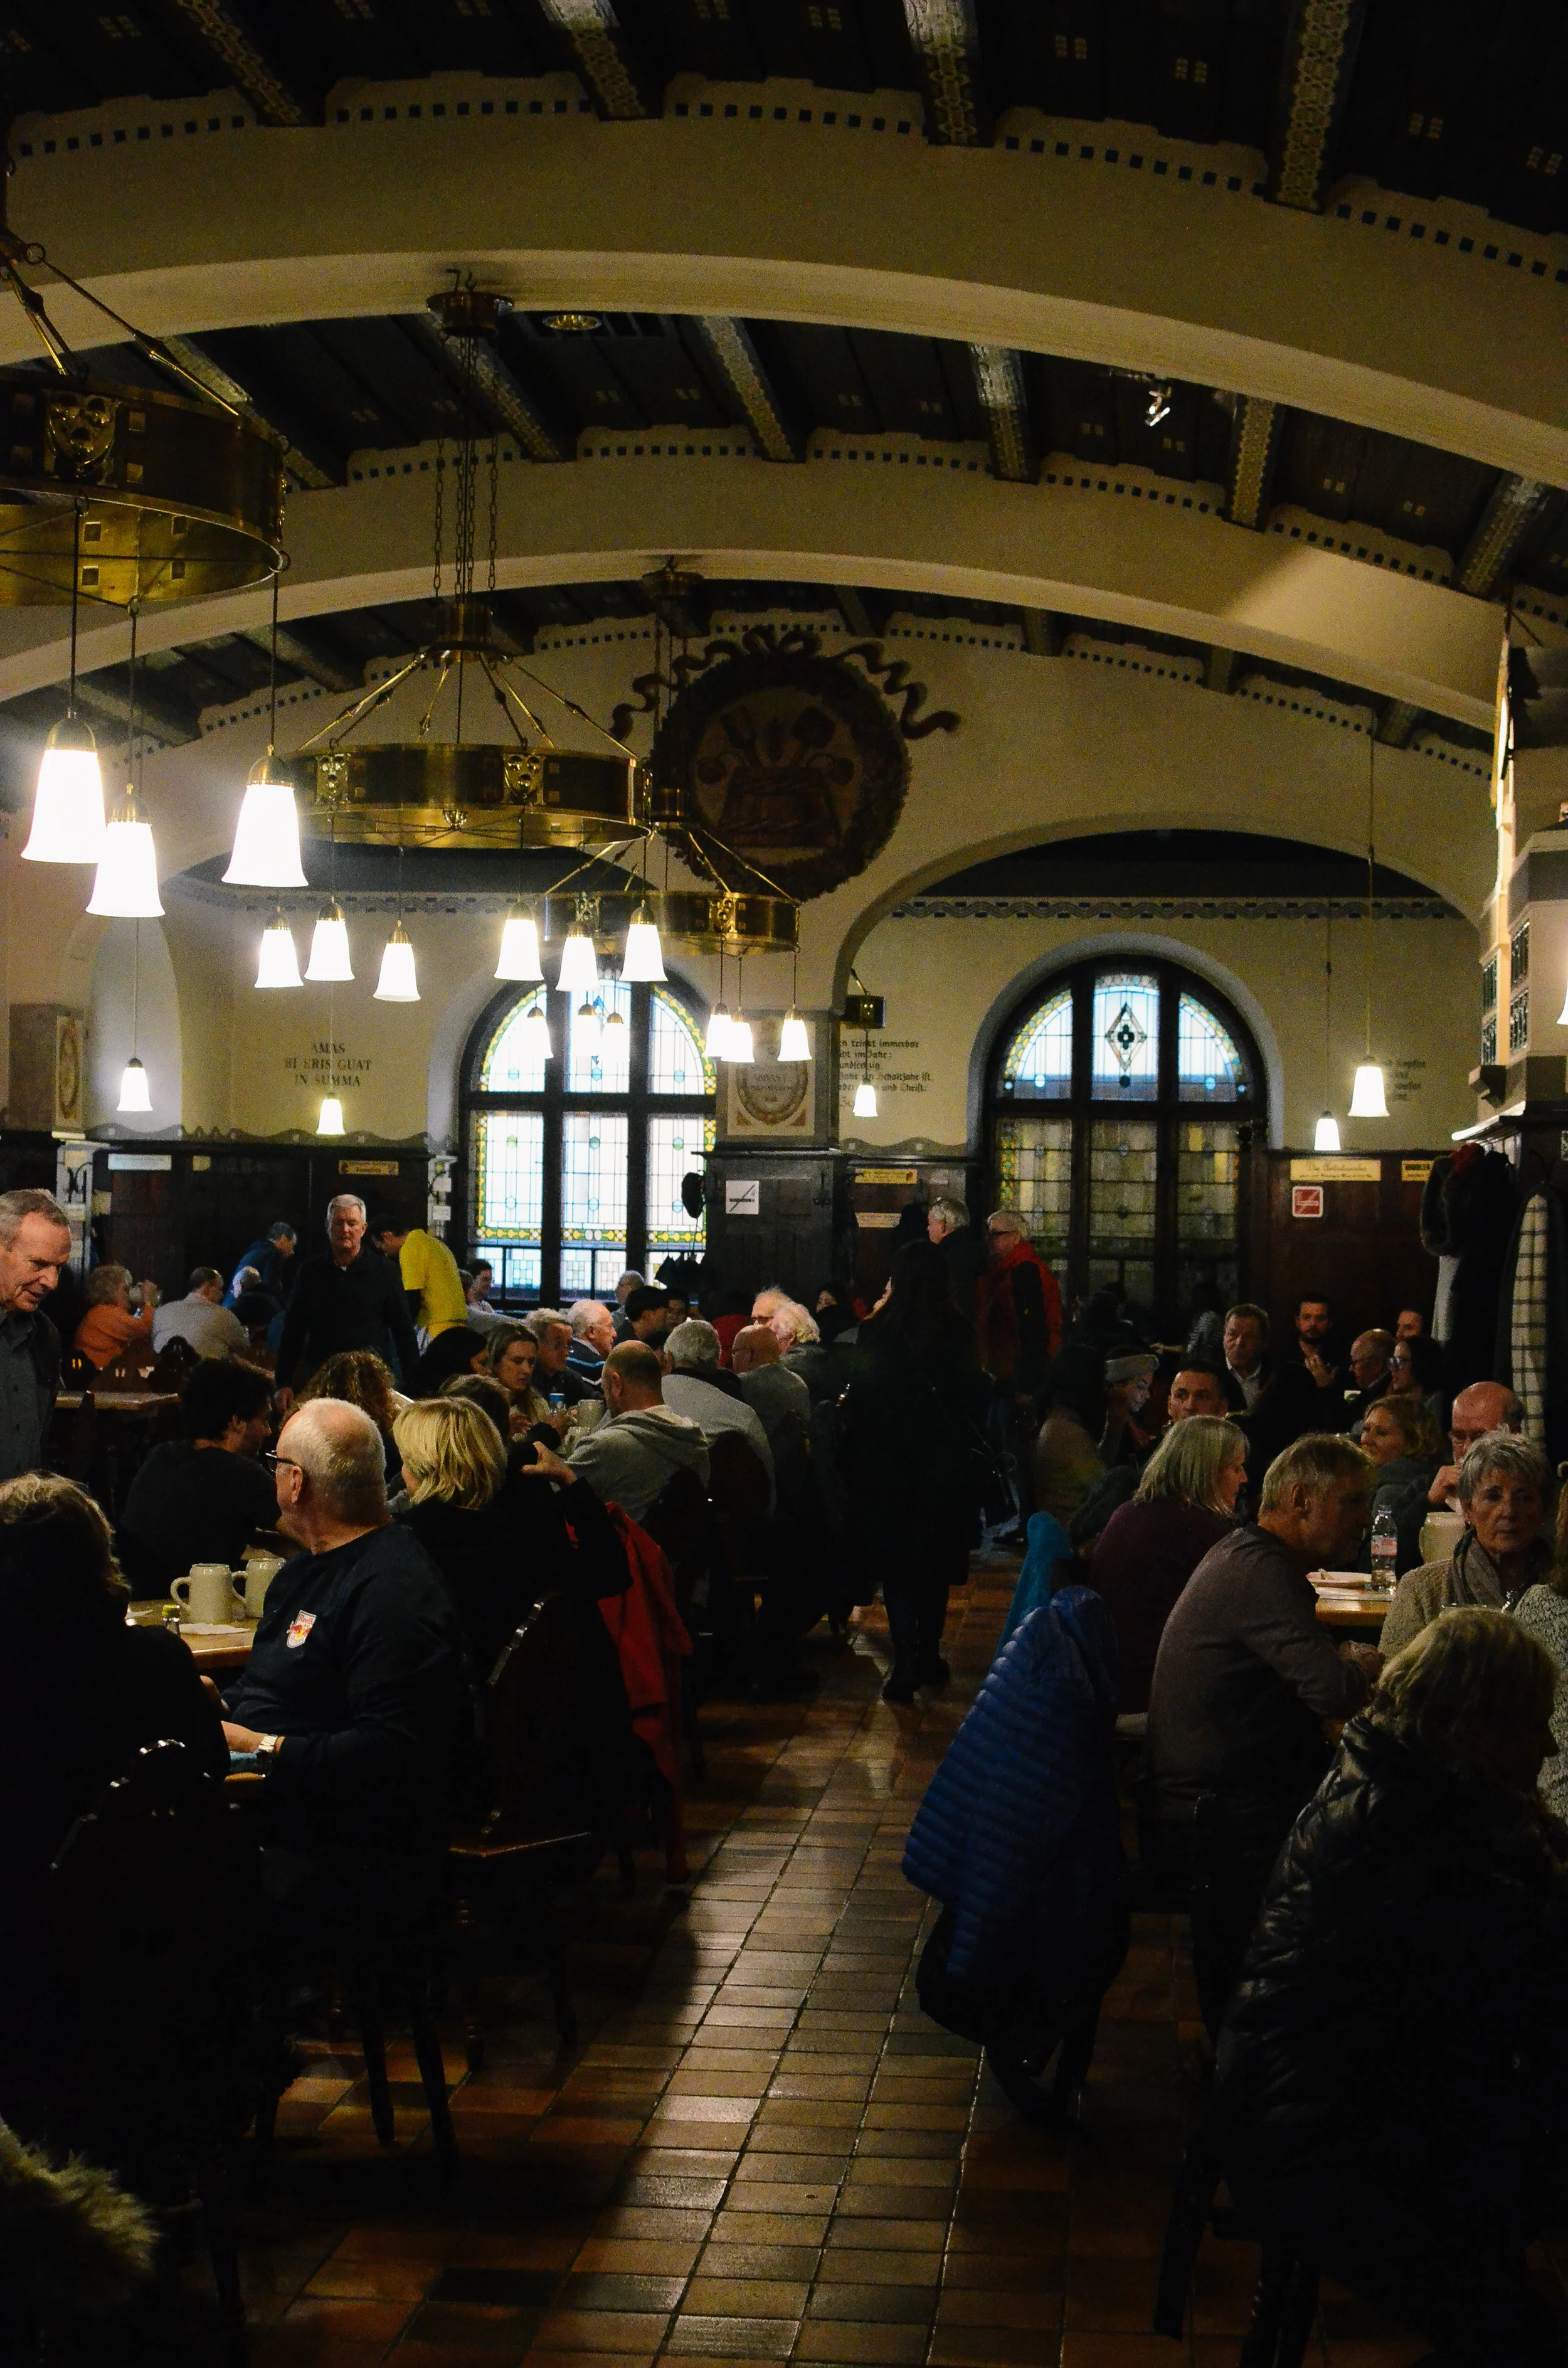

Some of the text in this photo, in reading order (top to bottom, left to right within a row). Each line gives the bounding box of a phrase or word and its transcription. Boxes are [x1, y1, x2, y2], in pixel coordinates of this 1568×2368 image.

[312, 1041, 346, 1054] AMAS
[337, 1058, 373, 1071] GUAT
[294, 1073, 361, 1087] IN SUMMA
